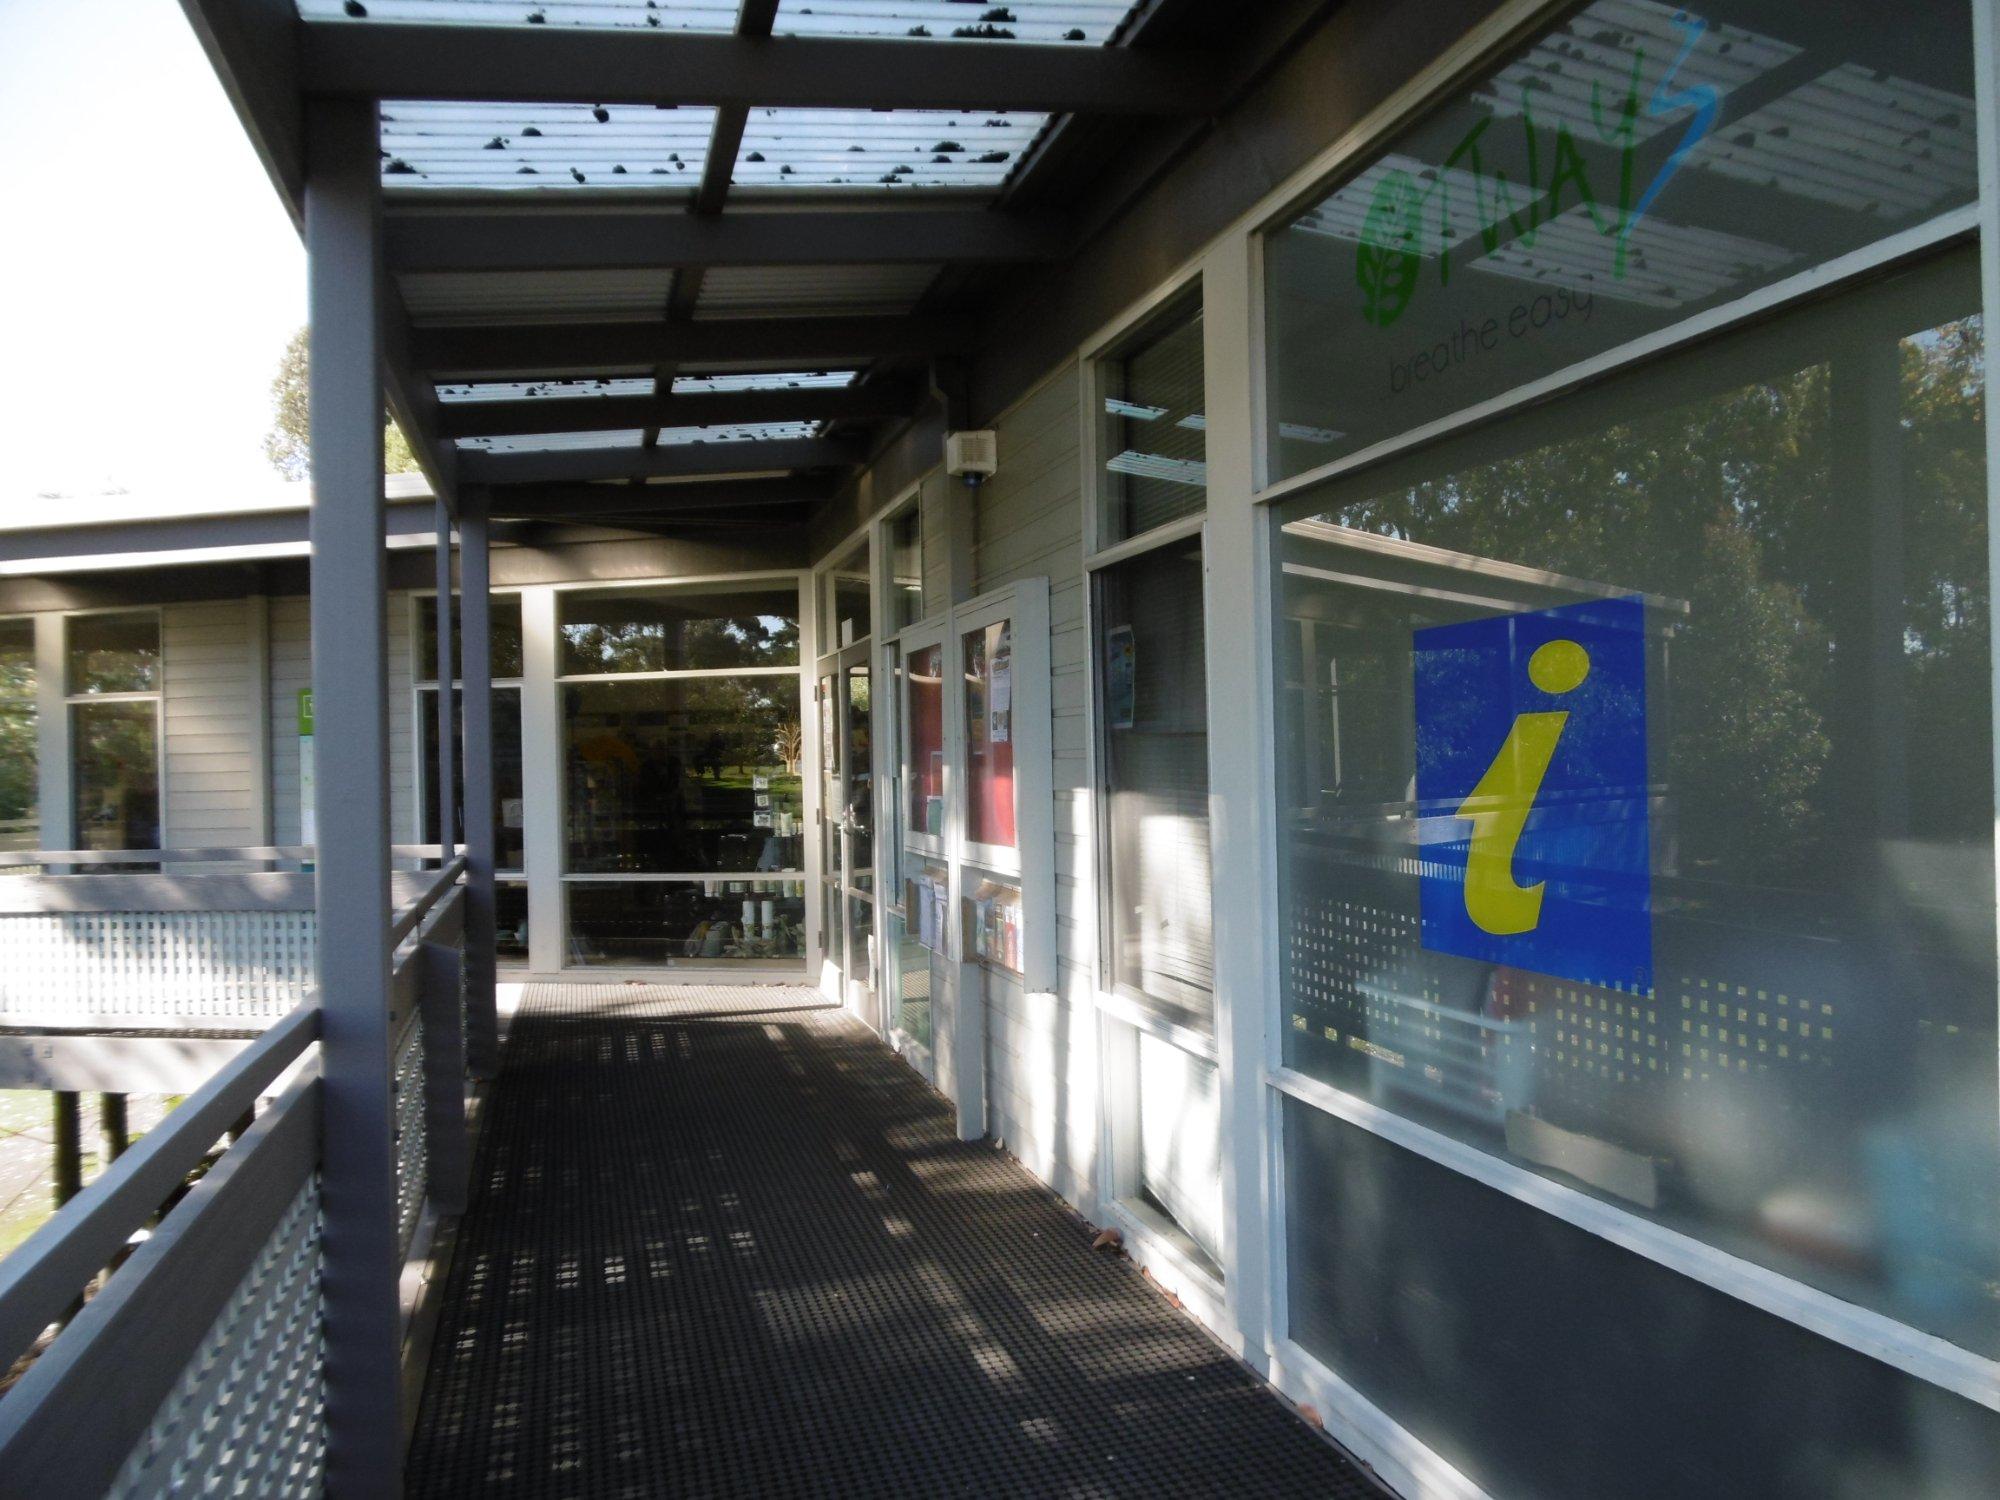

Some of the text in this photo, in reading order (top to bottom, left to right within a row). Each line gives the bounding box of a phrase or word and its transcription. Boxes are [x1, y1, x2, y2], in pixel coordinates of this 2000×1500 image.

[1390, 284, 1594, 394] breathe easy
[1455, 639, 1590, 936] i
